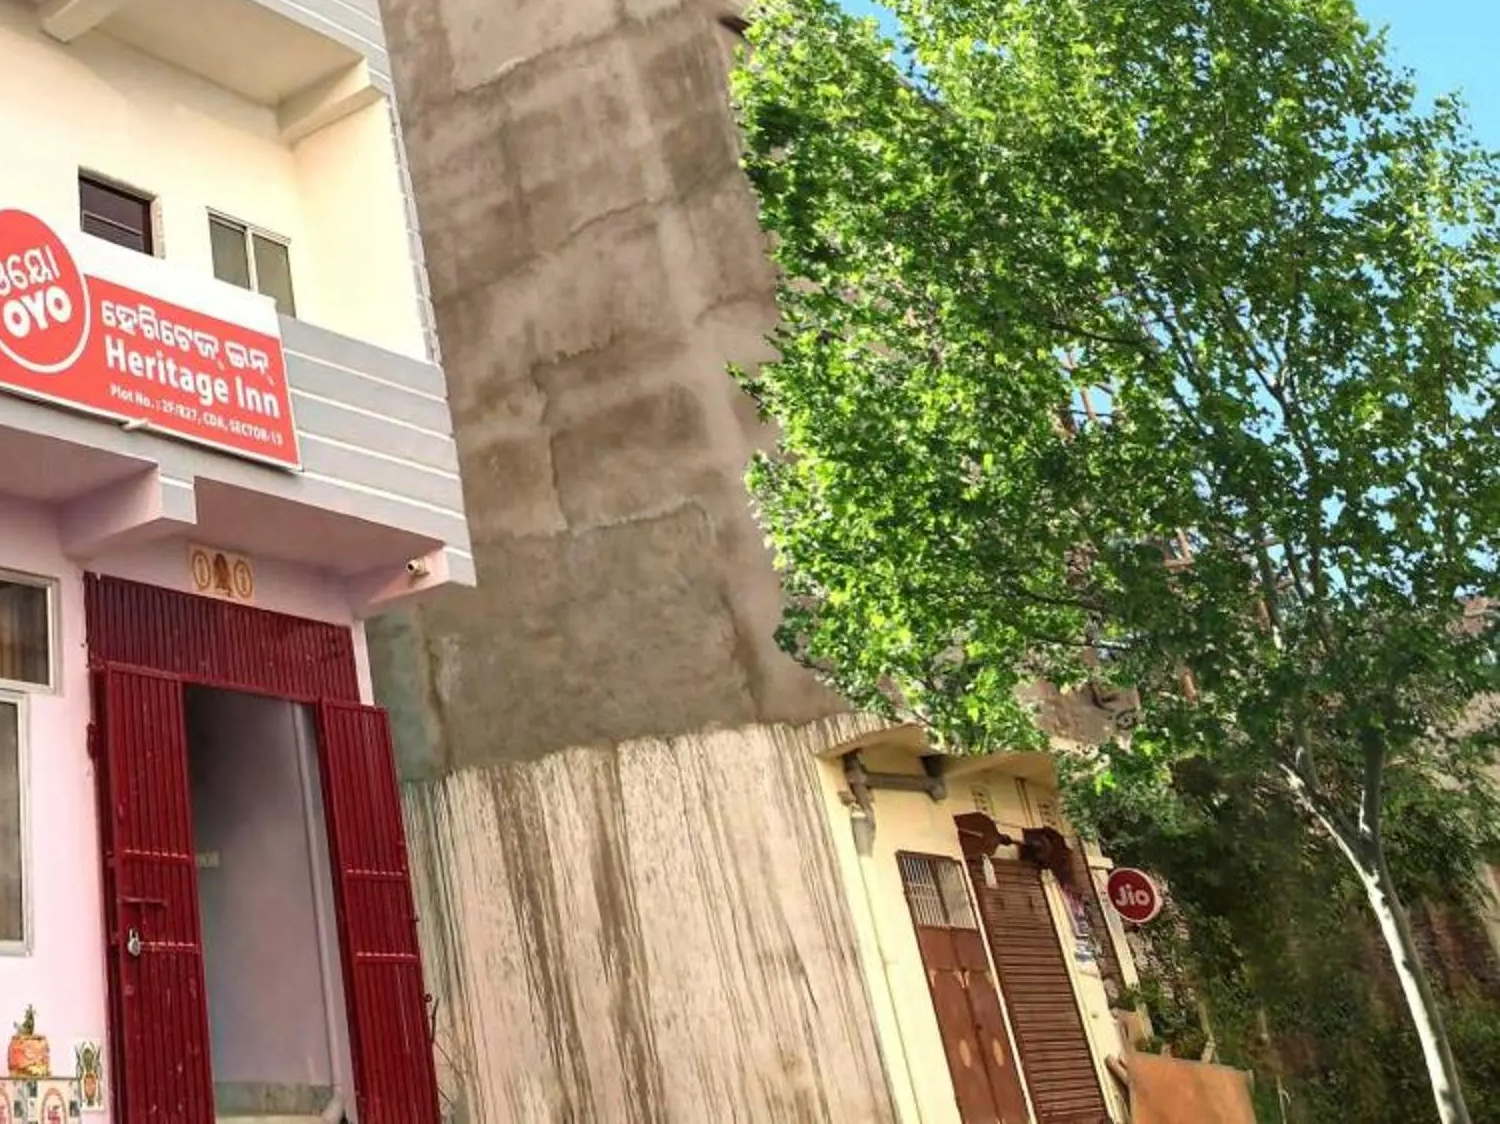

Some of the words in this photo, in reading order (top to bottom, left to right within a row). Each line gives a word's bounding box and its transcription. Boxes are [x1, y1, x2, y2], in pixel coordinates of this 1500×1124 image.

[3, 285, 72, 339] OYO
[104, 334, 230, 407] Heritage
[235, 374, 281, 419] Inn
[109, 383, 134, 404] Plot
[1115, 883, 1150, 907] Jio
